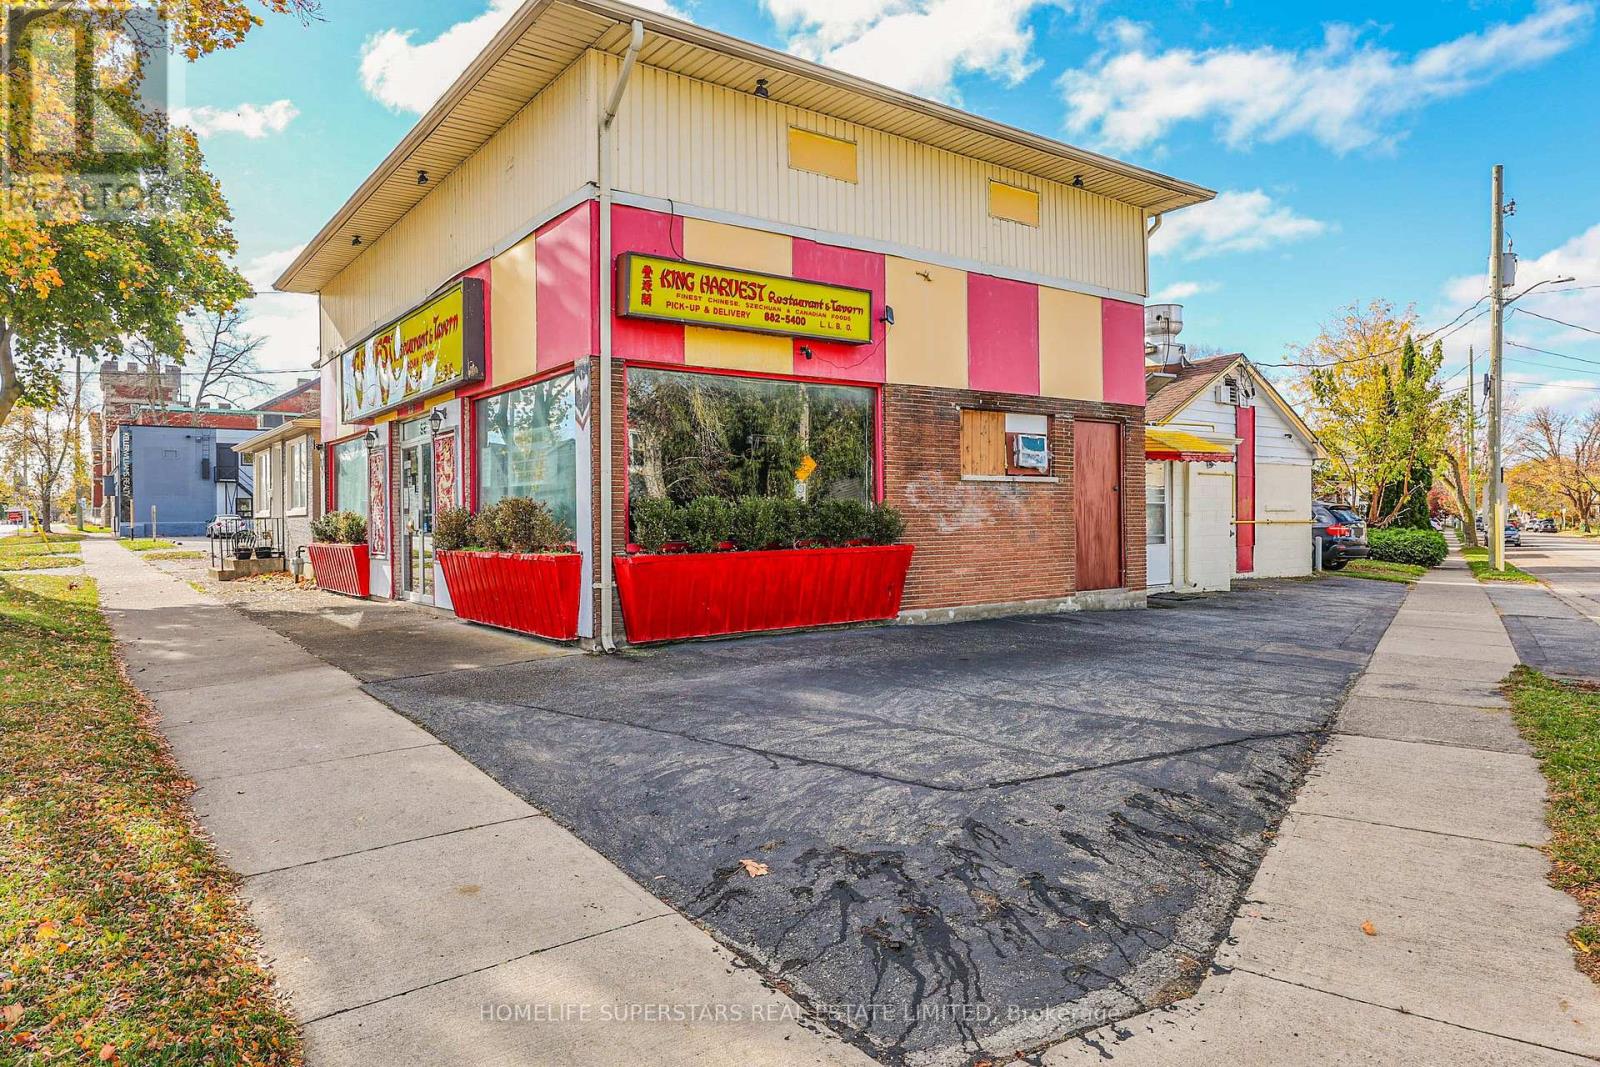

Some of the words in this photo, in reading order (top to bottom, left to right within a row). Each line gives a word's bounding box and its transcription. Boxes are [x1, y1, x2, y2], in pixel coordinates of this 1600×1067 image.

[660, 268, 695, 292] KING
[700, 274, 767, 302] HARVEST
[768, 291, 824, 310] Restaurant
[831, 299, 864, 316] Tavern
[666, 300, 701, 312] PICK-UP
[704, 305, 710, 314] &
[713, 306, 752, 319] DELIVERY
[676, 292, 703, 302] FINEST
[746, 302, 782, 312] SZECHUAN
[795, 309, 827, 319] CANADIAN
[831, 313, 852, 322] FOODS
[433, 313, 459, 341] Tavern
[122, 477, 132, 499] REALTY
